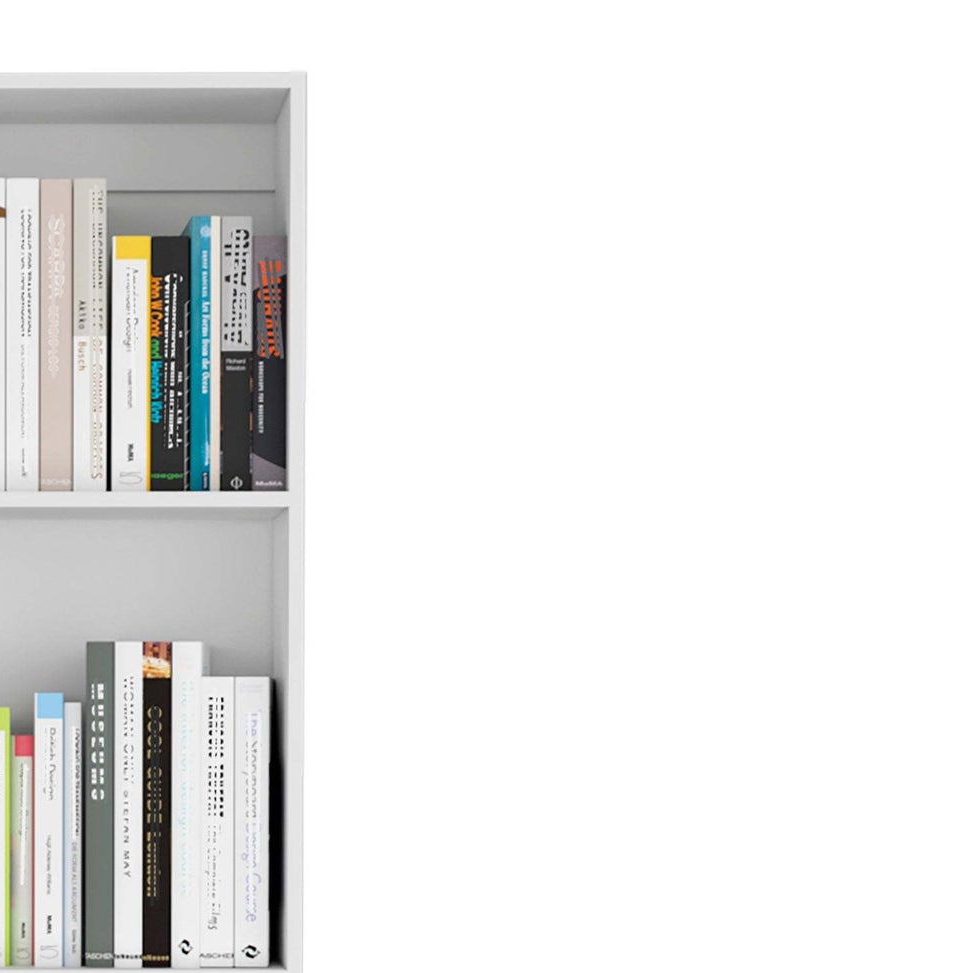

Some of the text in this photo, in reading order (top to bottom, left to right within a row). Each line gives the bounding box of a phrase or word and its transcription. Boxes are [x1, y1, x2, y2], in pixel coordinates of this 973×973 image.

[151, 275, 162, 297] John
[202, 300, 210, 313] Art
[77, 300, 87, 371] Akiko Busch
[202, 315, 210, 337] Forms
[151, 339, 162, 359] and
[202, 339, 210, 356] from
[202, 358, 210, 370] the
[151, 361, 162, 398] Heinrich
[202, 372, 210, 394] Ocean
